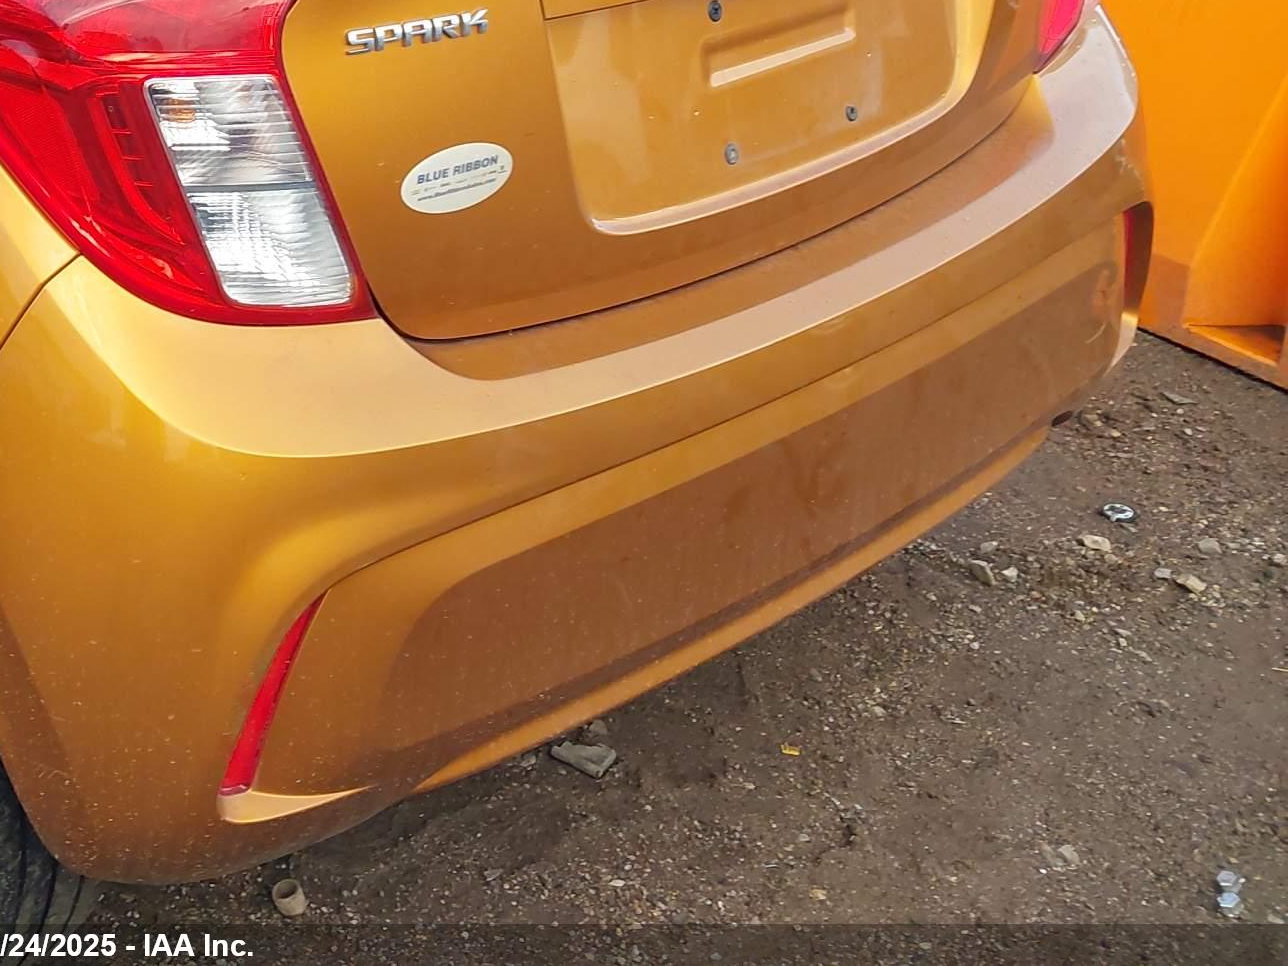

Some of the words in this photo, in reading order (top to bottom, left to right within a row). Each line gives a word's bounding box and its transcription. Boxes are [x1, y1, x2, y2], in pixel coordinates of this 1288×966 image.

[344, 8, 489, 55] SPARK
[416, 167, 450, 185] BLUE
[452, 154, 499, 176] RIBBON
